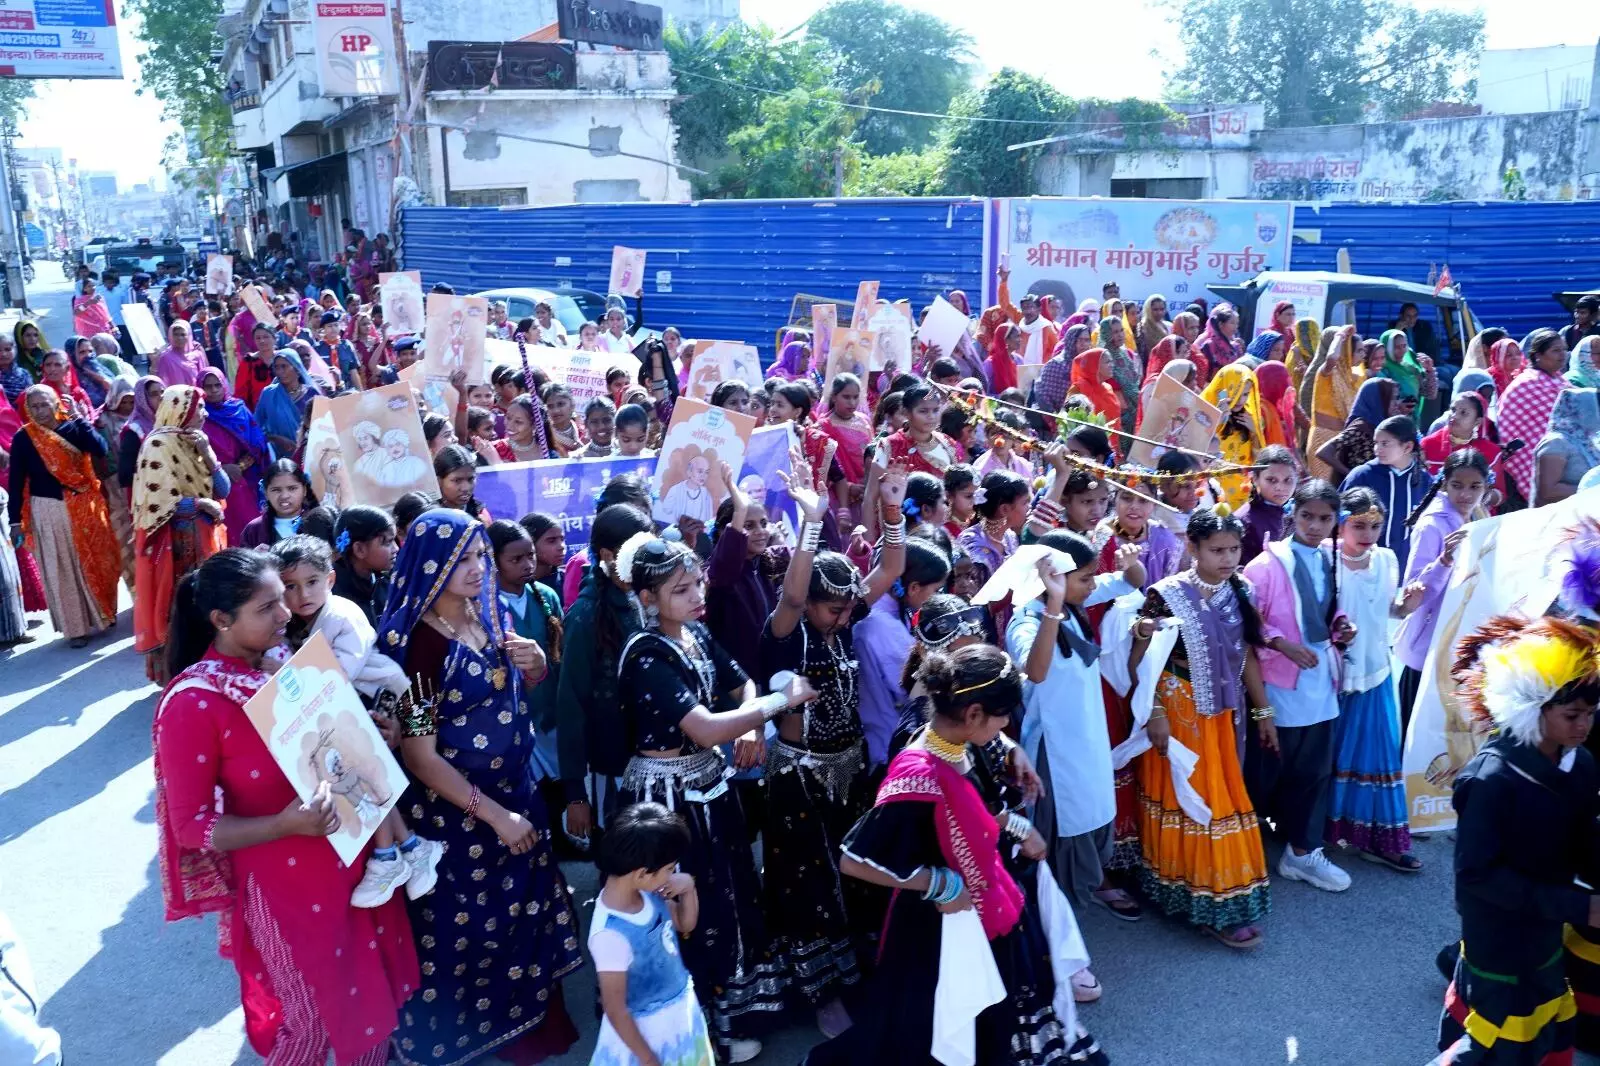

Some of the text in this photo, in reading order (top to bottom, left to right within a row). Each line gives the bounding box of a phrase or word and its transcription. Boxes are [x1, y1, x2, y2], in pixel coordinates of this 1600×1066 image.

[341, 35, 372, 52] HP
[1027, 241, 1267, 280] श्रीमान् मांगुभाई गुर्जर
[1174, 283, 1189, 293] को
[1279, 283, 1308, 292] VISHAL
[549, 477, 571, 491] 150
